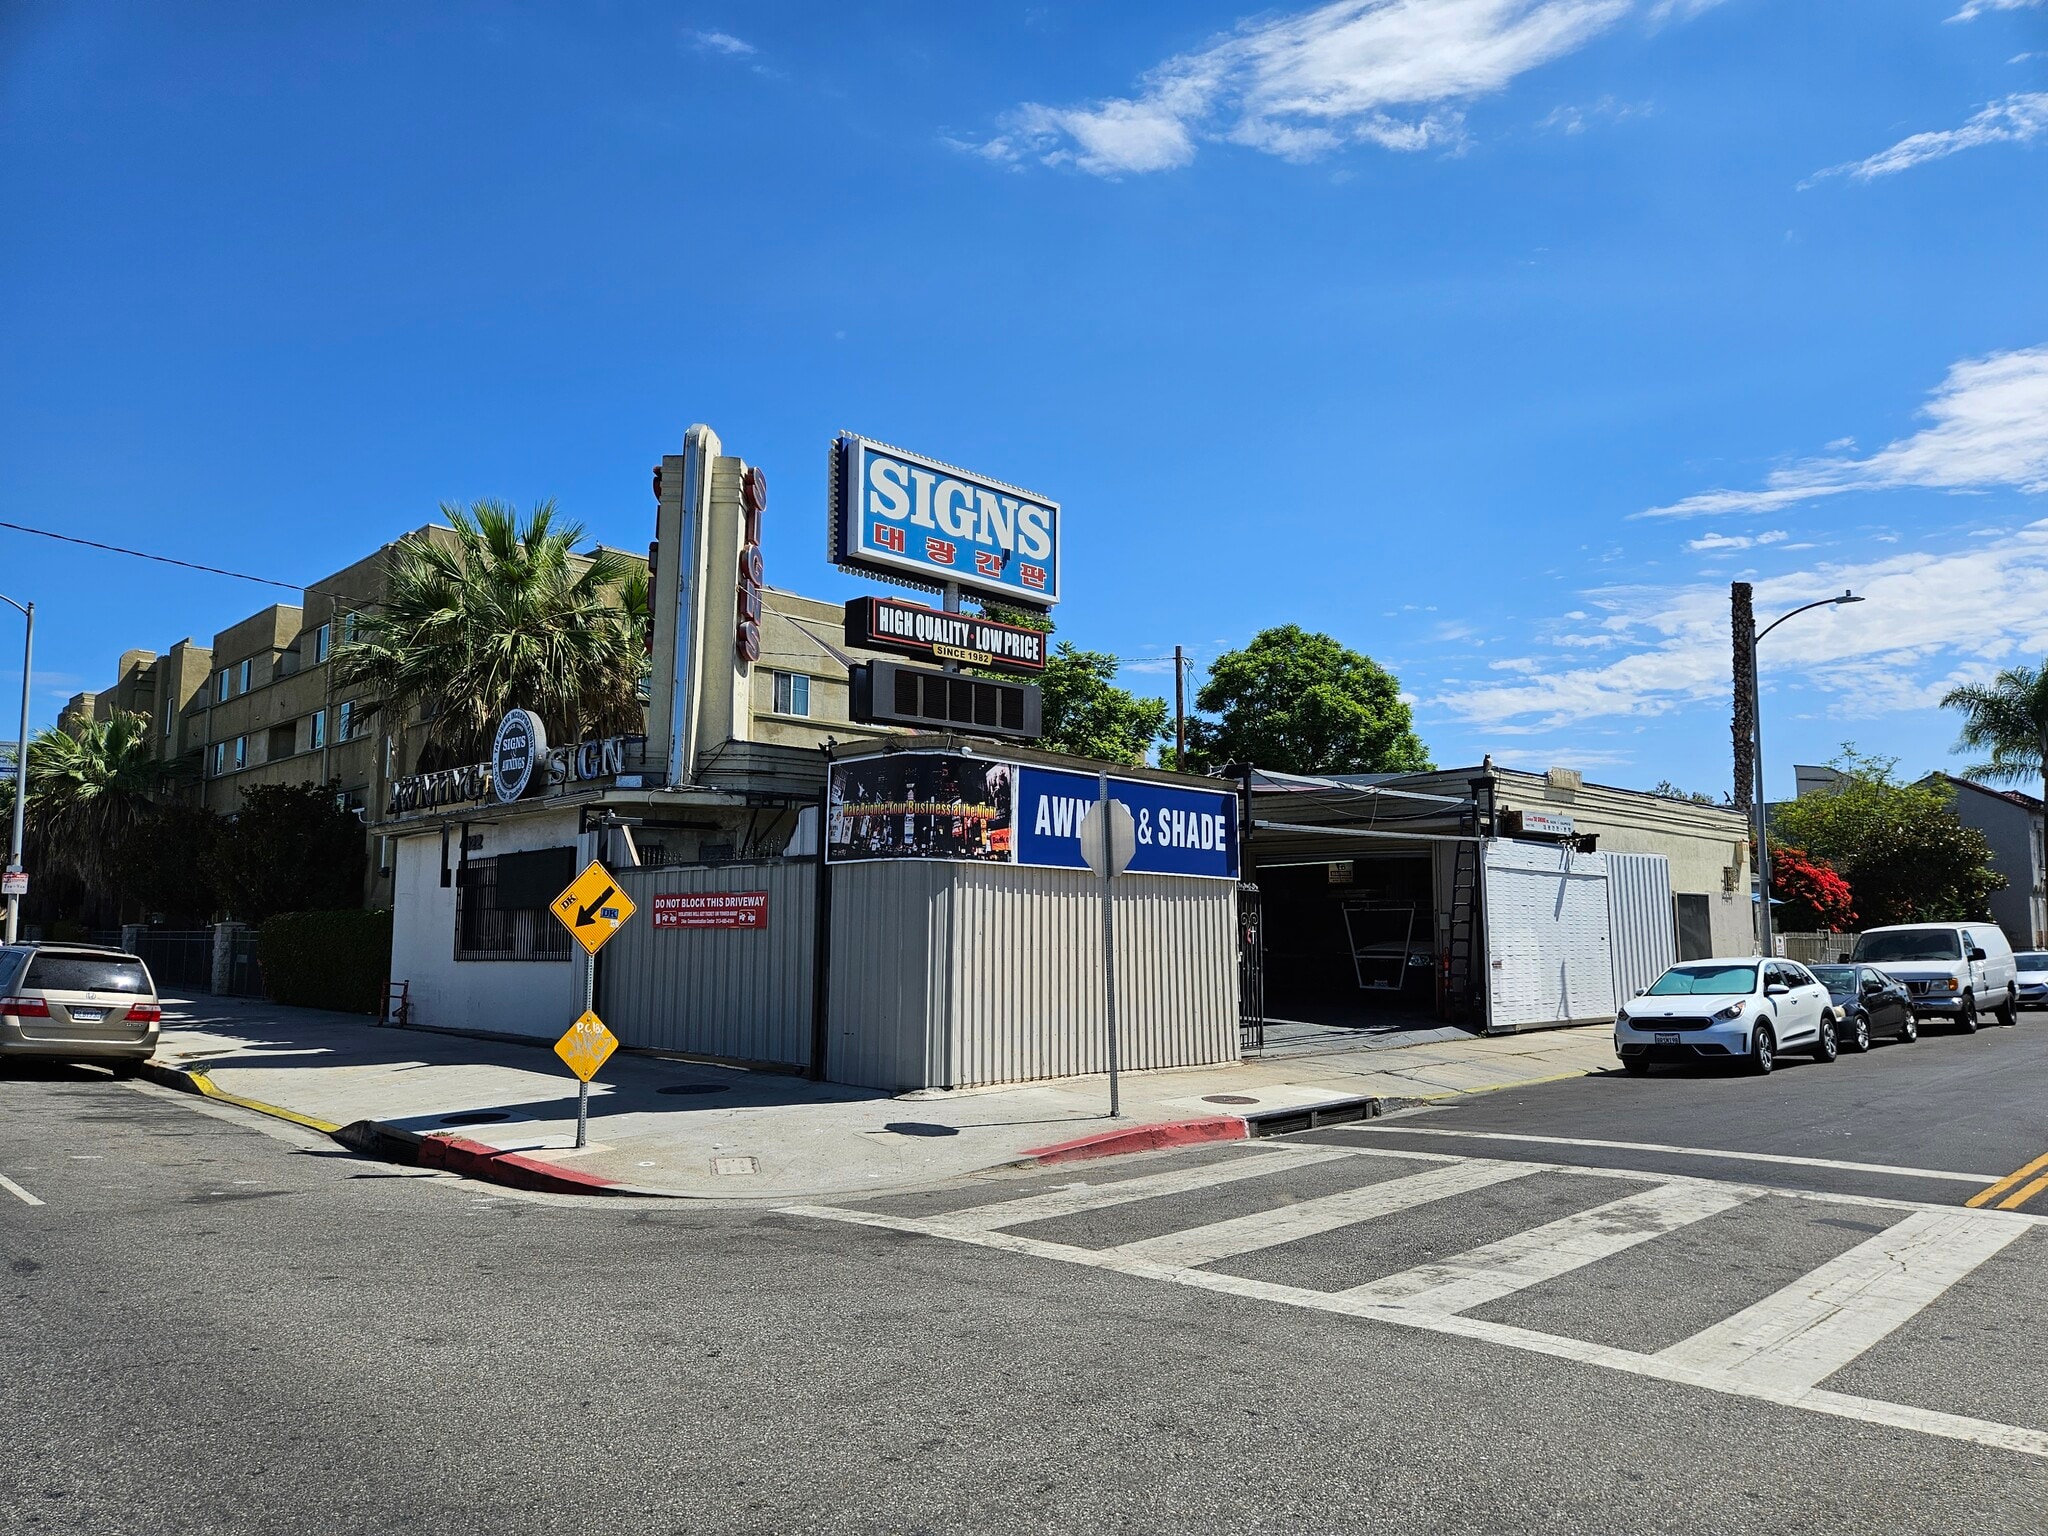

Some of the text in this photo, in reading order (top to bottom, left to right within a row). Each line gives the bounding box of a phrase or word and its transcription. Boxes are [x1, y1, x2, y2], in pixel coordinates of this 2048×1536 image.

[870, 458, 1051, 560] SIGNS
[879, 606, 1039, 661] HIGH QUALITY LOW PRICE
[937, 646, 989, 663] SINCE 1982
[502, 735, 526, 751] SIGNS
[548, 738, 624, 785] SIGN
[843, 800, 997, 820] Make Brighter Your Business at the Night
[1138, 812, 1153, 845] &
[1158, 808, 1226, 852] SHADE
[561, 895, 576, 909] DK
[655, 896, 765, 909] DO NOT BLOCK THIS DRIVEWAY
[602, 909, 616, 917] DK
